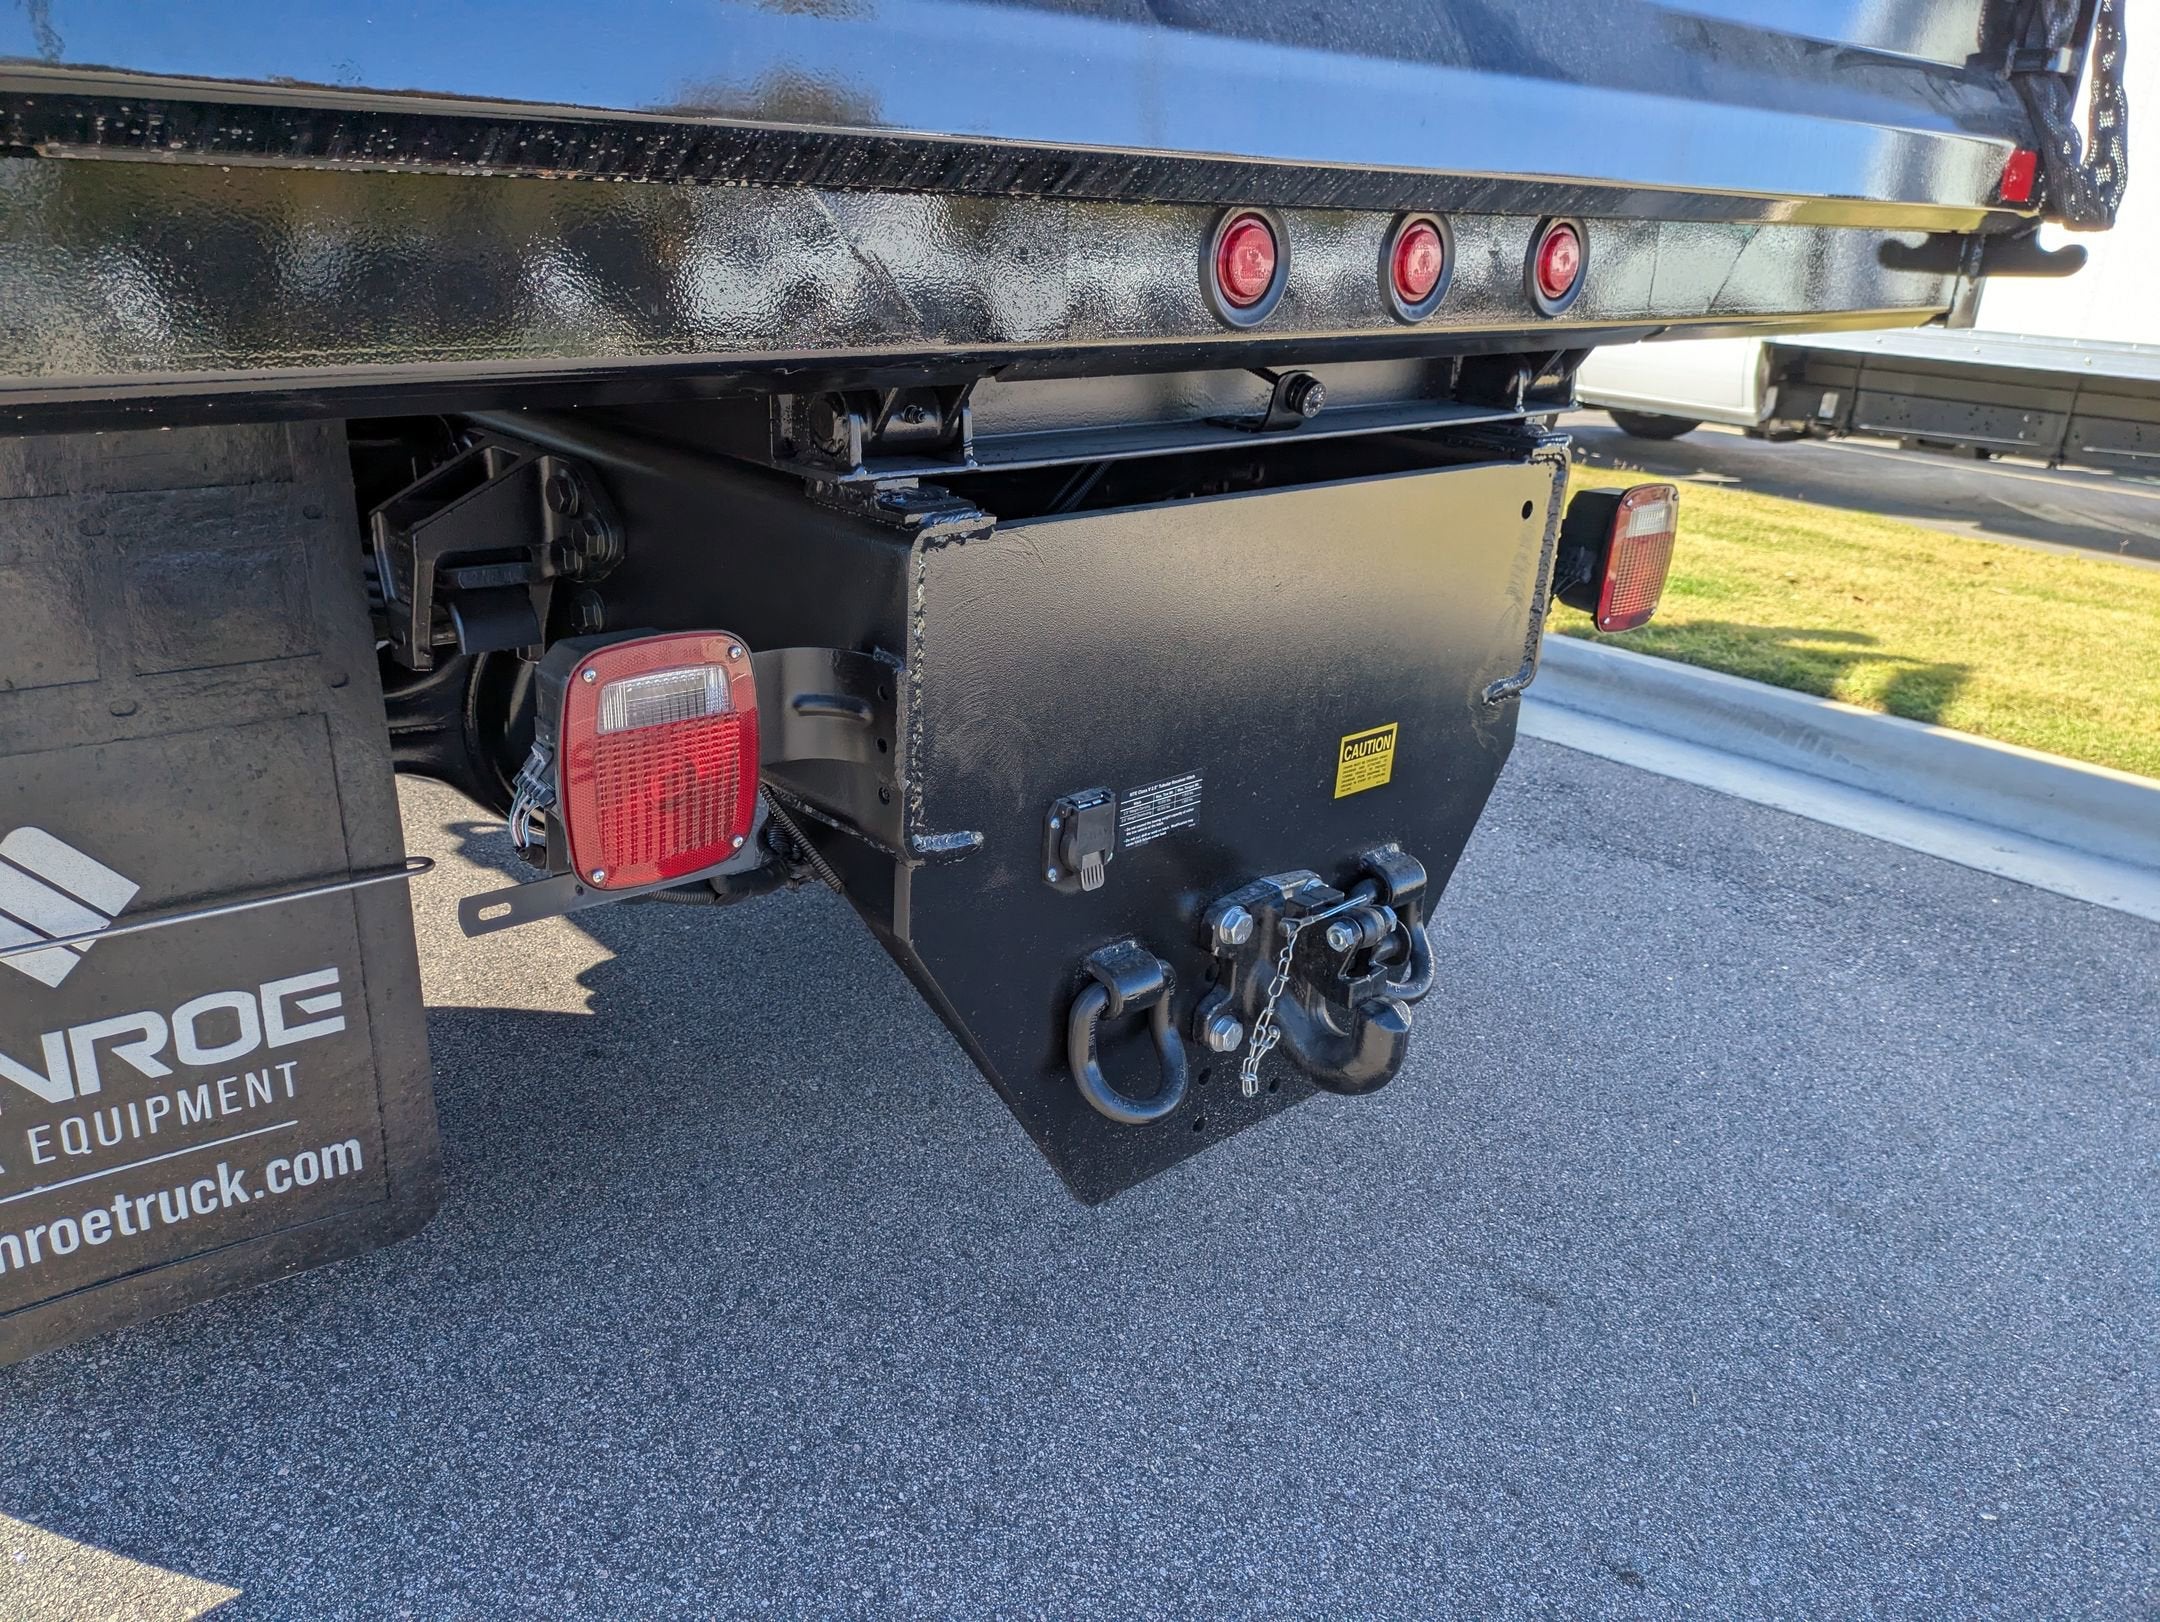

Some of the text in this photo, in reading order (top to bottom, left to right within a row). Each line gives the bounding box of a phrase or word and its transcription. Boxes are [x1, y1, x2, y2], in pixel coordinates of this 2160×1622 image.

[1344, 734, 1392, 761] CAUTION
[27, 1061, 299, 1165] EQUIPMENT
[0, 1137, 364, 1274] nroetruck.com
